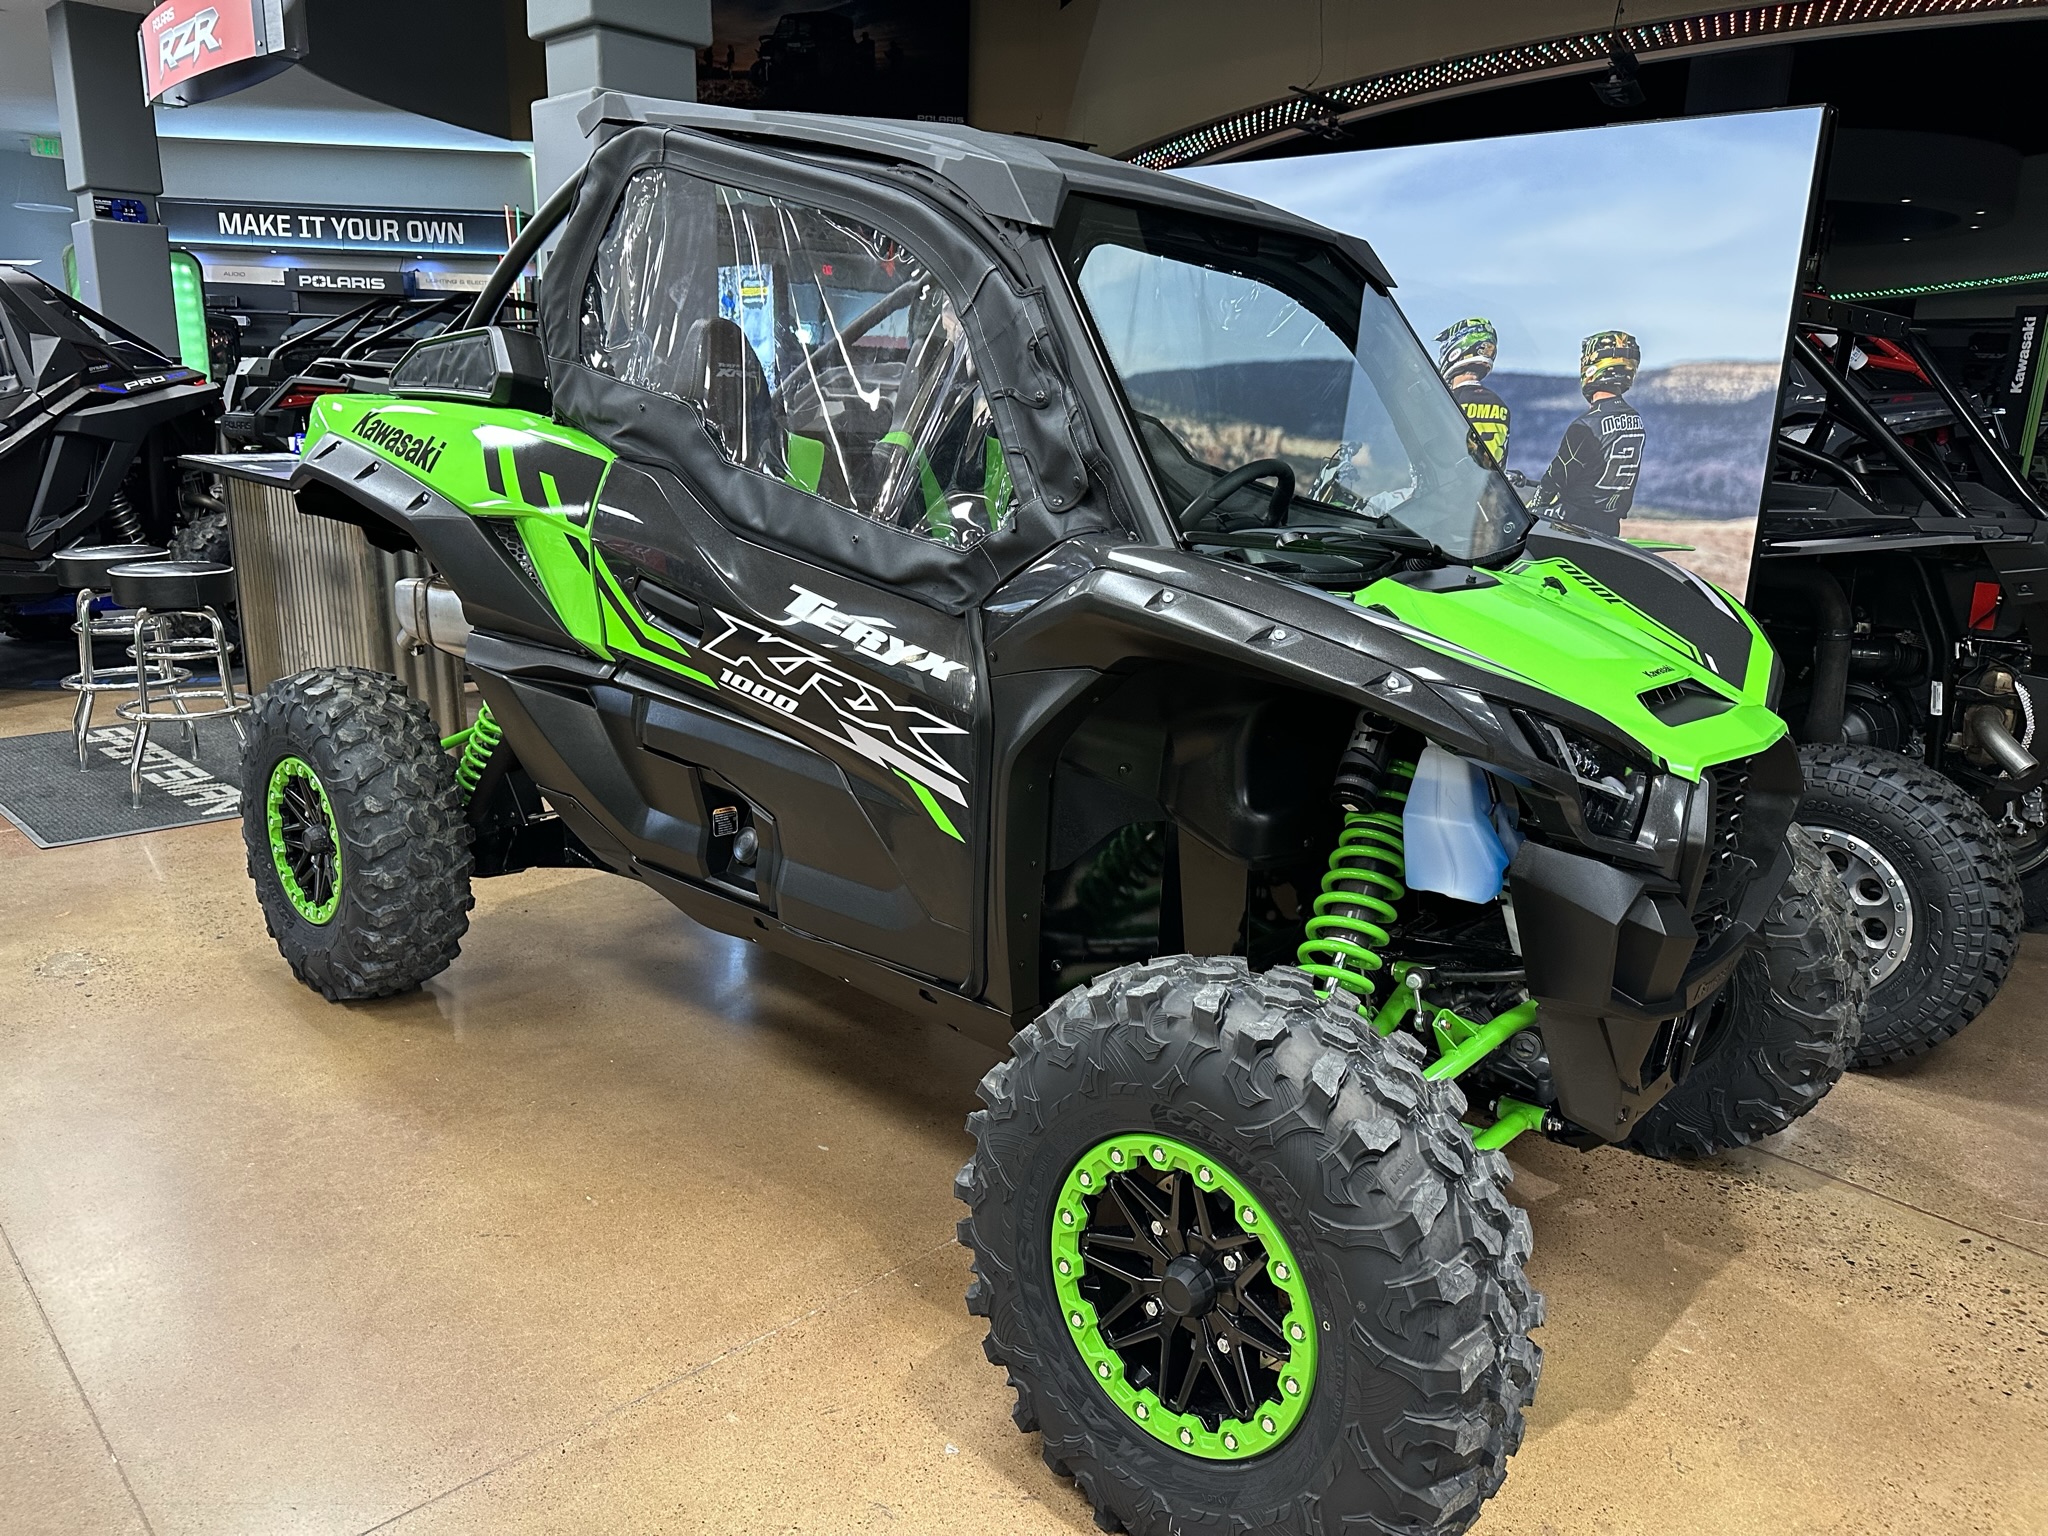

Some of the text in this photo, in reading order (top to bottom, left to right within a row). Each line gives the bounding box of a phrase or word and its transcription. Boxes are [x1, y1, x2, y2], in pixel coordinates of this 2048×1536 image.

[159, 6, 220, 82] RZR
[218, 212, 464, 244] MAKE IT YOUR OWN
[298, 274, 386, 290] POLARIS
[2009, 316, 2037, 394] Kawasaki
[124, 374, 167, 392] PRO
[351, 410, 448, 475] Kawasaki
[1594, 433, 1646, 491] 2
[1556, 563, 1624, 605] 1000
[701, 606, 971, 785] KRX
[719, 667, 800, 714] 1000
